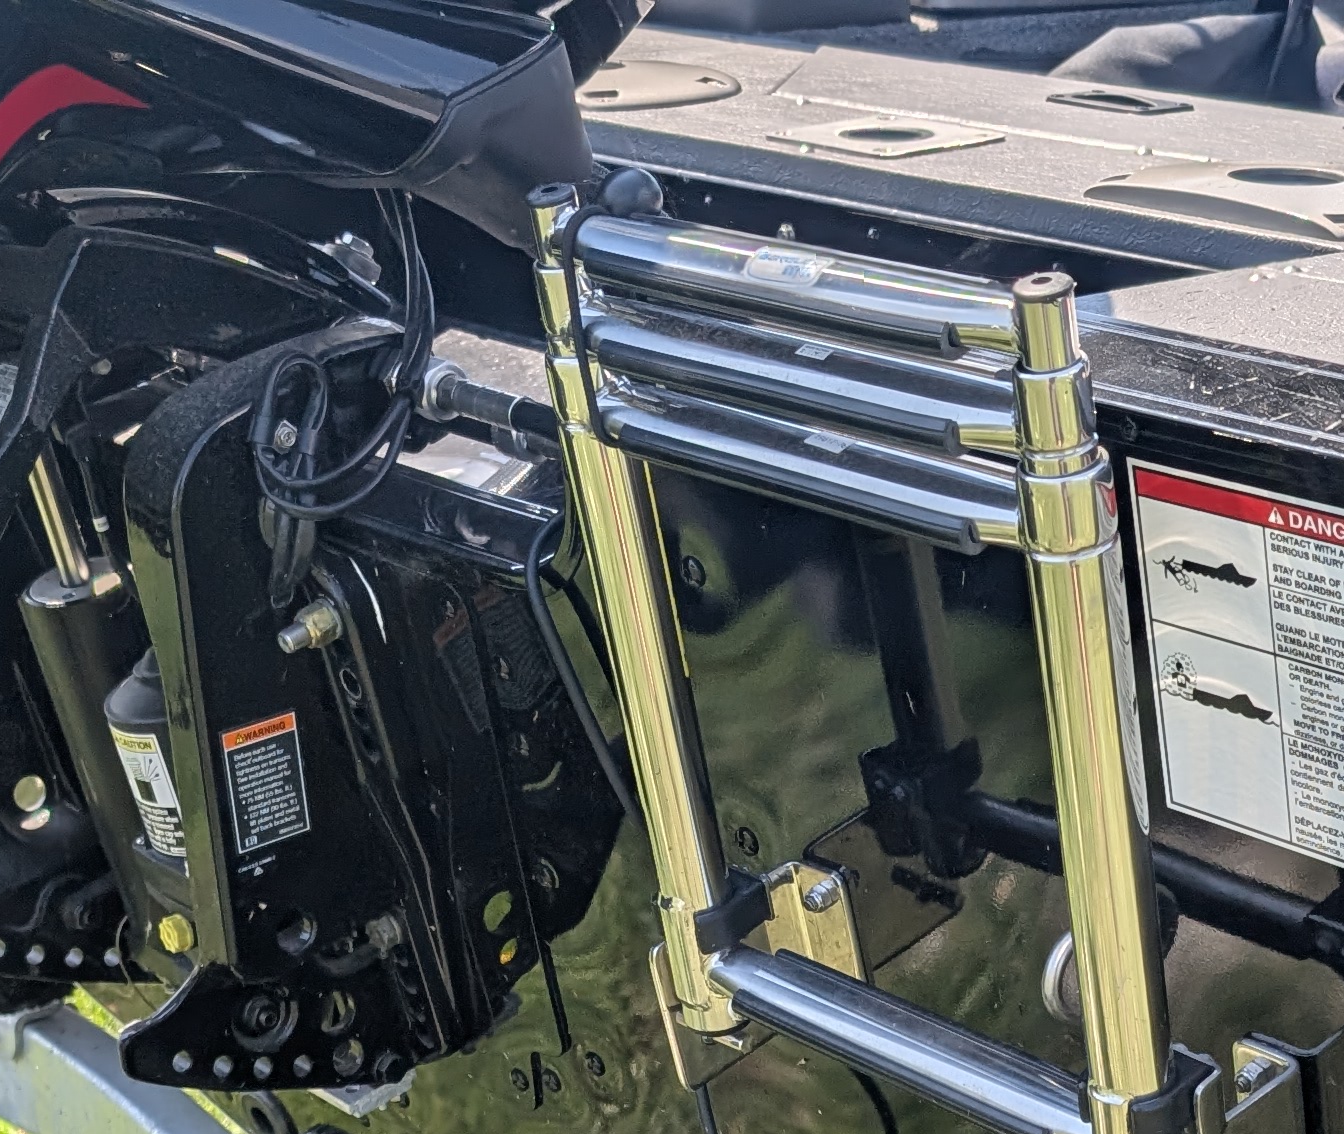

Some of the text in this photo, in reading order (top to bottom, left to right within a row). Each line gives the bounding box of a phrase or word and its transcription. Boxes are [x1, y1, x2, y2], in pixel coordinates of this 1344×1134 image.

[1270, 532, 1311, 550] CONTACT
[1313, 543, 1336, 556] WITH
[1339, 550, 1344, 558] A
[1271, 543, 1310, 560] SERIOUS
[1312, 554, 1344, 569] INJURY
[1273, 564, 1294, 576] STAY
[1296, 570, 1326, 585] CLEAR
[1329, 578, 1341, 588] OF
[1274, 575, 1292, 587] AND
[1295, 580, 1342, 600] BOARDING
[1273, 590, 1284, 600] LE
[1286, 594, 1327, 611] CONTACT
[1274, 601, 1291, 613] DES
[1276, 623, 1307, 638] QUAND
[1309, 632, 1320, 642] LE
[1278, 644, 1323, 664] BAIGNADE
[1288, 663, 1323, 679] CARBON
[1289, 673, 1332, 691] OR DEATH.
[244, 722, 285, 740] WARNING
[1293, 719, 1317, 732] MOVE
[1318, 727, 1329, 736] TO
[1288, 738, 1299, 748] LE
[1289, 747, 1339, 770] DOMMAGES
